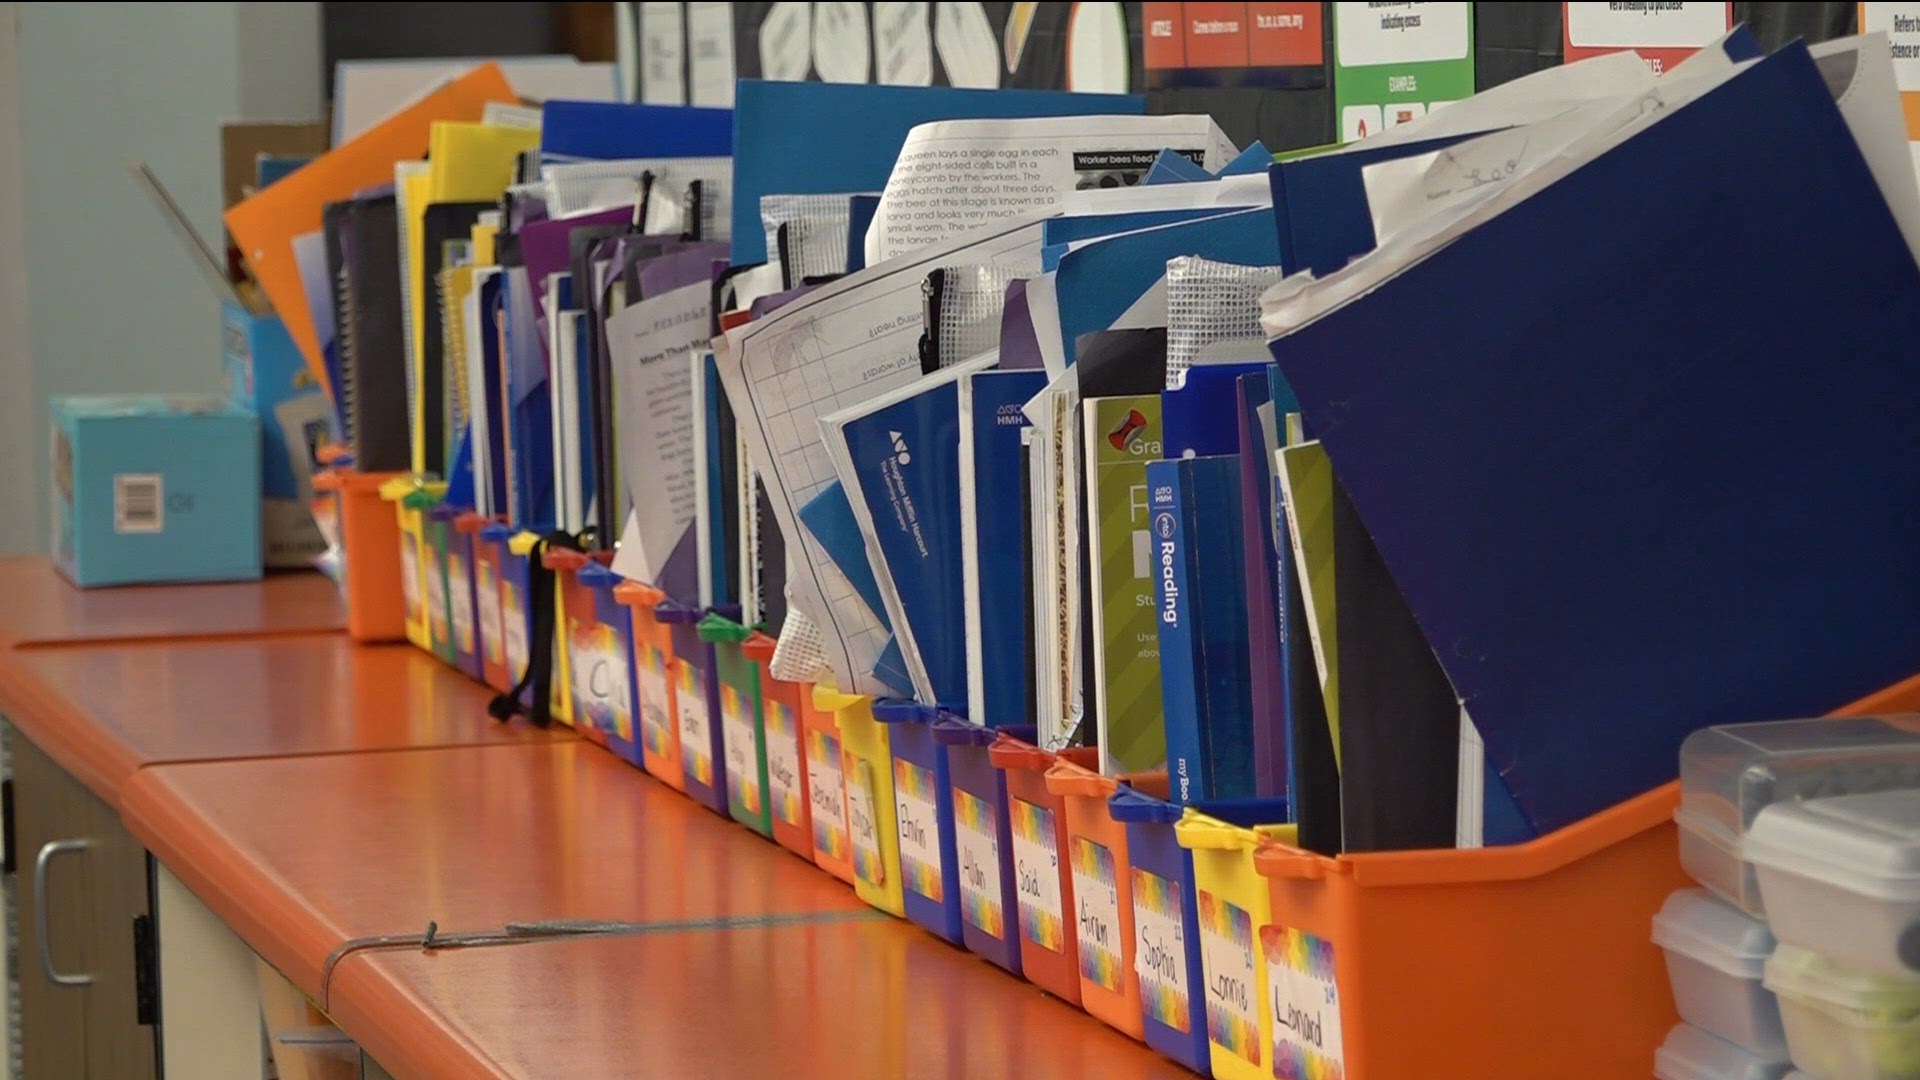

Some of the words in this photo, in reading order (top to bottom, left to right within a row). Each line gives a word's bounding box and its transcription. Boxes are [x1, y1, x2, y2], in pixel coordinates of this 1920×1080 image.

[1895, 14, 1914, 32] Refers
[939, 150, 958, 160] lays
[969, 149, 995, 160] single
[1020, 148, 1030, 157] in
[1032, 148, 1058, 157] each
[1078, 156, 1108, 165] Worker
[1110, 154, 1131, 164] bees
[915, 161, 972, 172] eight-sided
[996, 161, 1016, 169] built
[1019, 161, 1028, 169] in
[948, 173, 962, 183] by
[964, 173, 980, 182] the
[1023, 172, 1041, 181] The
[911, 187, 943, 197] hatch
[944, 186, 969, 195] after
[971, 185, 1000, 194] about
[1002, 184, 1028, 193] three
[906, 199, 927, 208] bee
[930, 199, 940, 207] at
[942, 197, 959, 207] this
[961, 197, 988, 208] stage
[990, 196, 998, 206] is
[999, 196, 1032, 206] known
[1034, 197, 1046, 205] as
[887, 211, 911, 221] larva
[914, 209, 935, 220] and
[937, 208, 962, 219] looks
[964, 209, 985, 221] very
[987, 208, 1016, 219] much
[887, 223, 913, 233] small
[948, 222, 965, 231] The
[888, 236, 904, 246] the
[864, 363, 895, 381] words?
[997, 416, 1023, 425] HMH
[1130, 439, 1162, 455] Gra
[889, 457, 906, 496] Houghton
[912, 522, 928, 557] Harcourt
[1161, 541, 1178, 623] Reading
[1137, 634, 1157, 642] Use
[1207, 948, 1248, 1012] Lonnie
